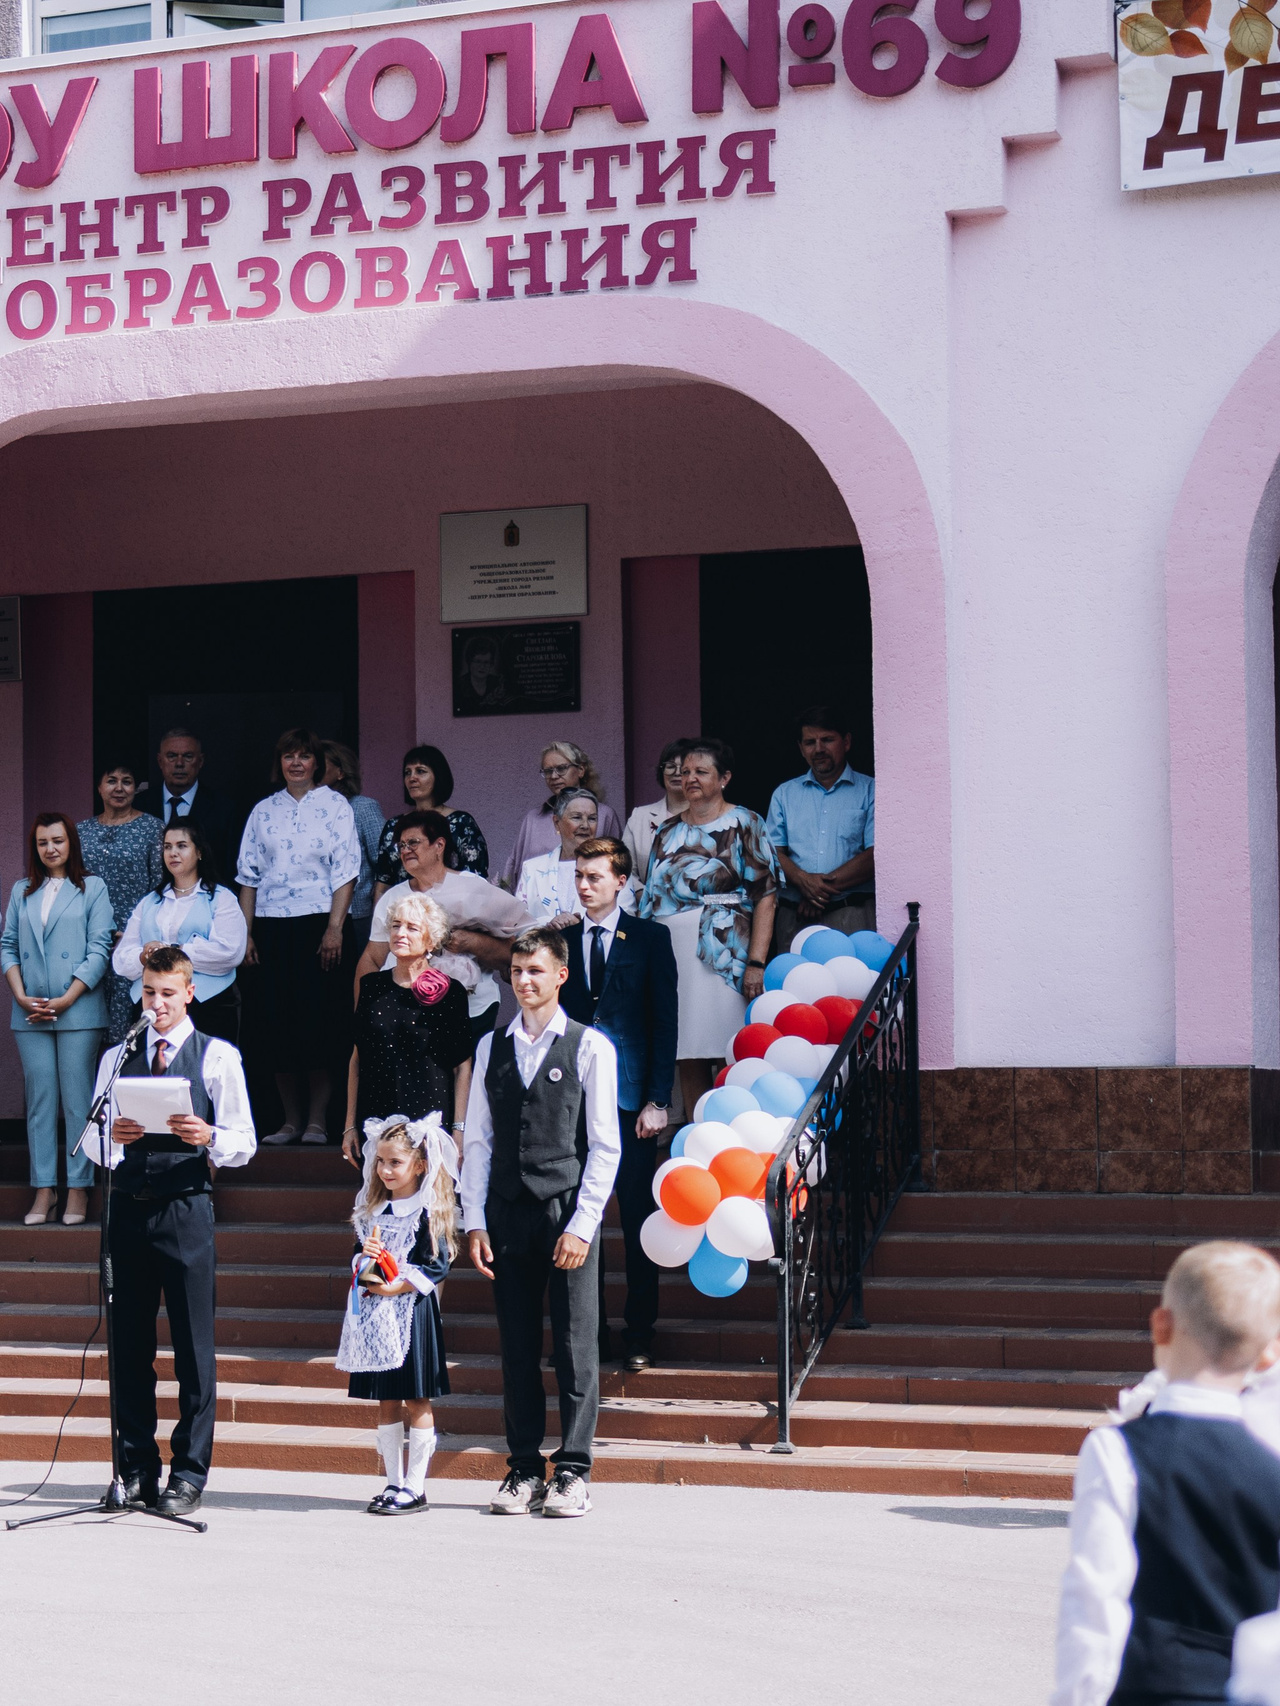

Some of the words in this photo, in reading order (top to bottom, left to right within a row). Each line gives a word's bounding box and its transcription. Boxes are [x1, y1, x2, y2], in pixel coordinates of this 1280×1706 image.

[133, 12, 649, 175] ШКОЛА
[692, 0, 1021, 114] №69
[262, 128, 777, 242] РАЗВИТИЯ
[5, 217, 699, 341] ОБРАЗОВАНИЯ
[470, 562, 518, 570] МУНИЦИПАЛЬНОЕ
[479, 568, 546, 577] ОБЩЕОБРАЗОВАТЕЛЬНОЕ
